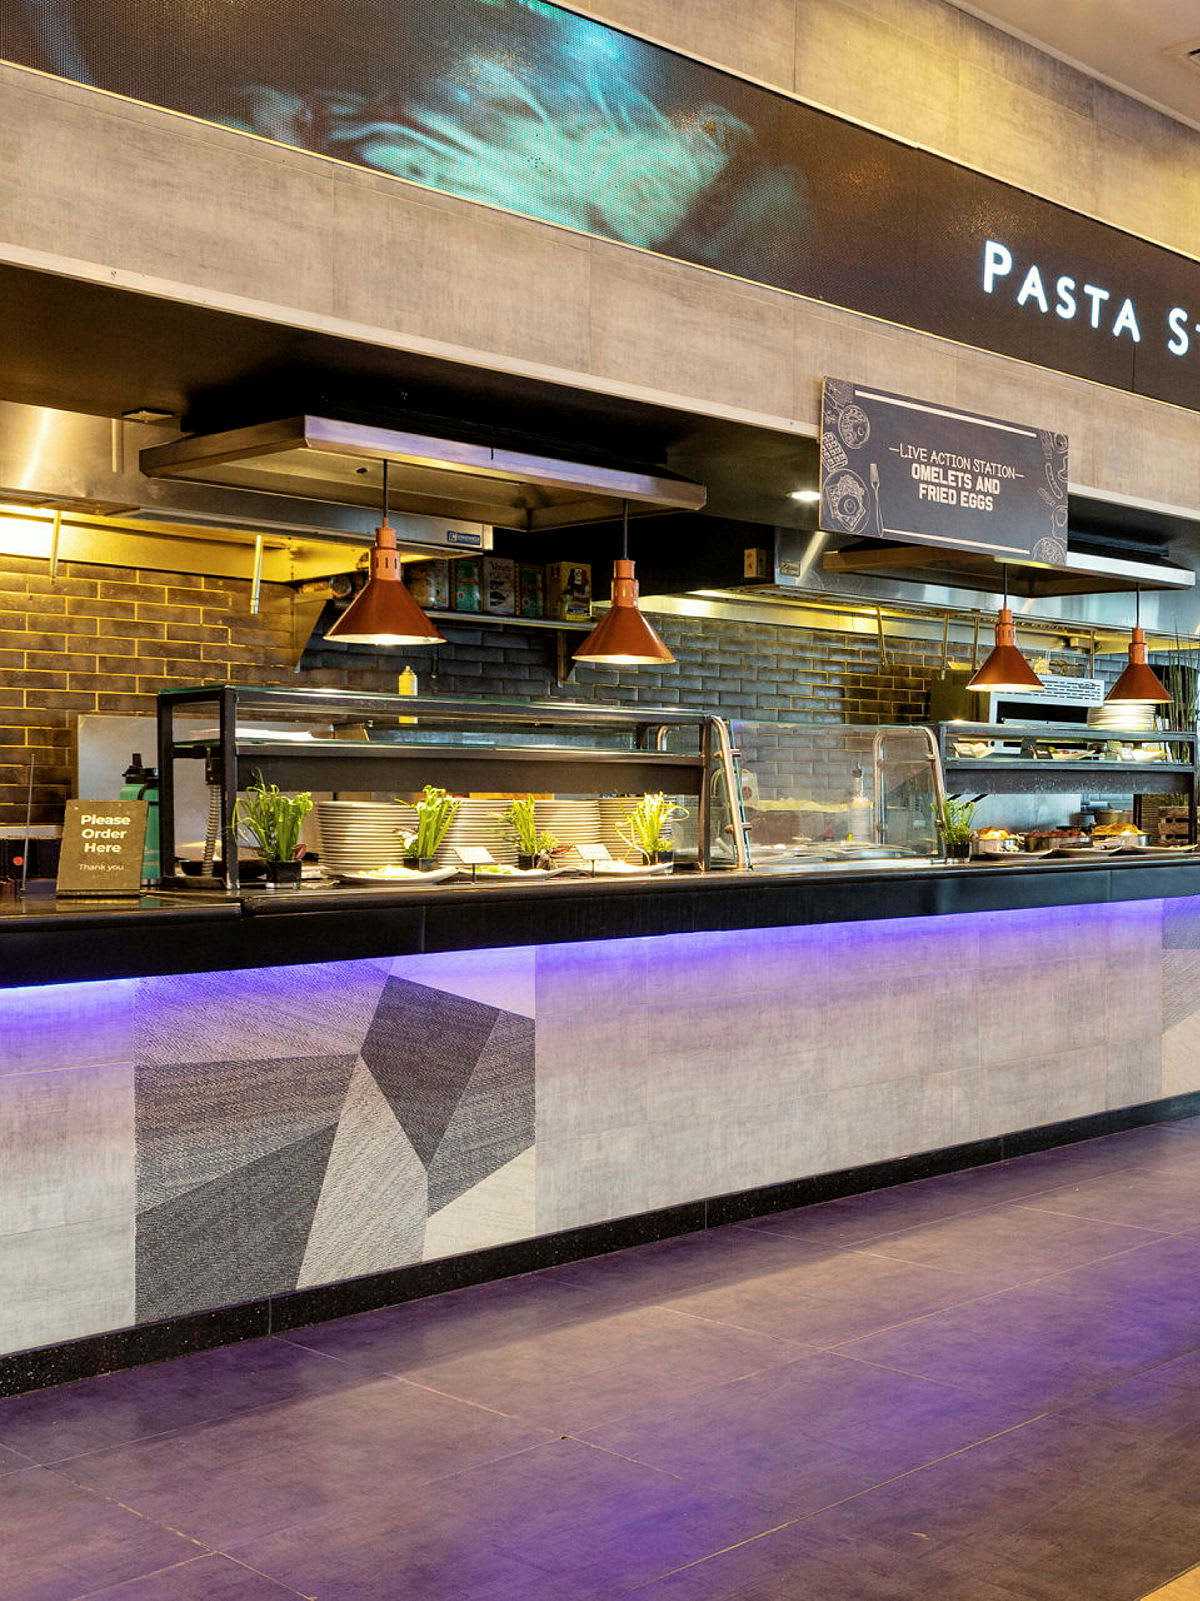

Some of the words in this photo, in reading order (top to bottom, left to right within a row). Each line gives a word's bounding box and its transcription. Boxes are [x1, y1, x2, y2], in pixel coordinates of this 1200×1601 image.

[983, 239, 1141, 343] PASTA
[900, 443, 927, 461] LIVE
[930, 450, 970, 470] ACTION
[973, 459, 1016, 480] STATION
[911, 463, 972, 489] OMELETS
[976, 477, 1000, 494] AND
[919, 484, 957, 505] FRIED
[960, 492, 993, 511] EGGS
[80, 814, 131, 825] Please
[82, 828, 127, 839] Order
[84, 842, 122, 853] Here
[79, 863, 106, 871] Thank
